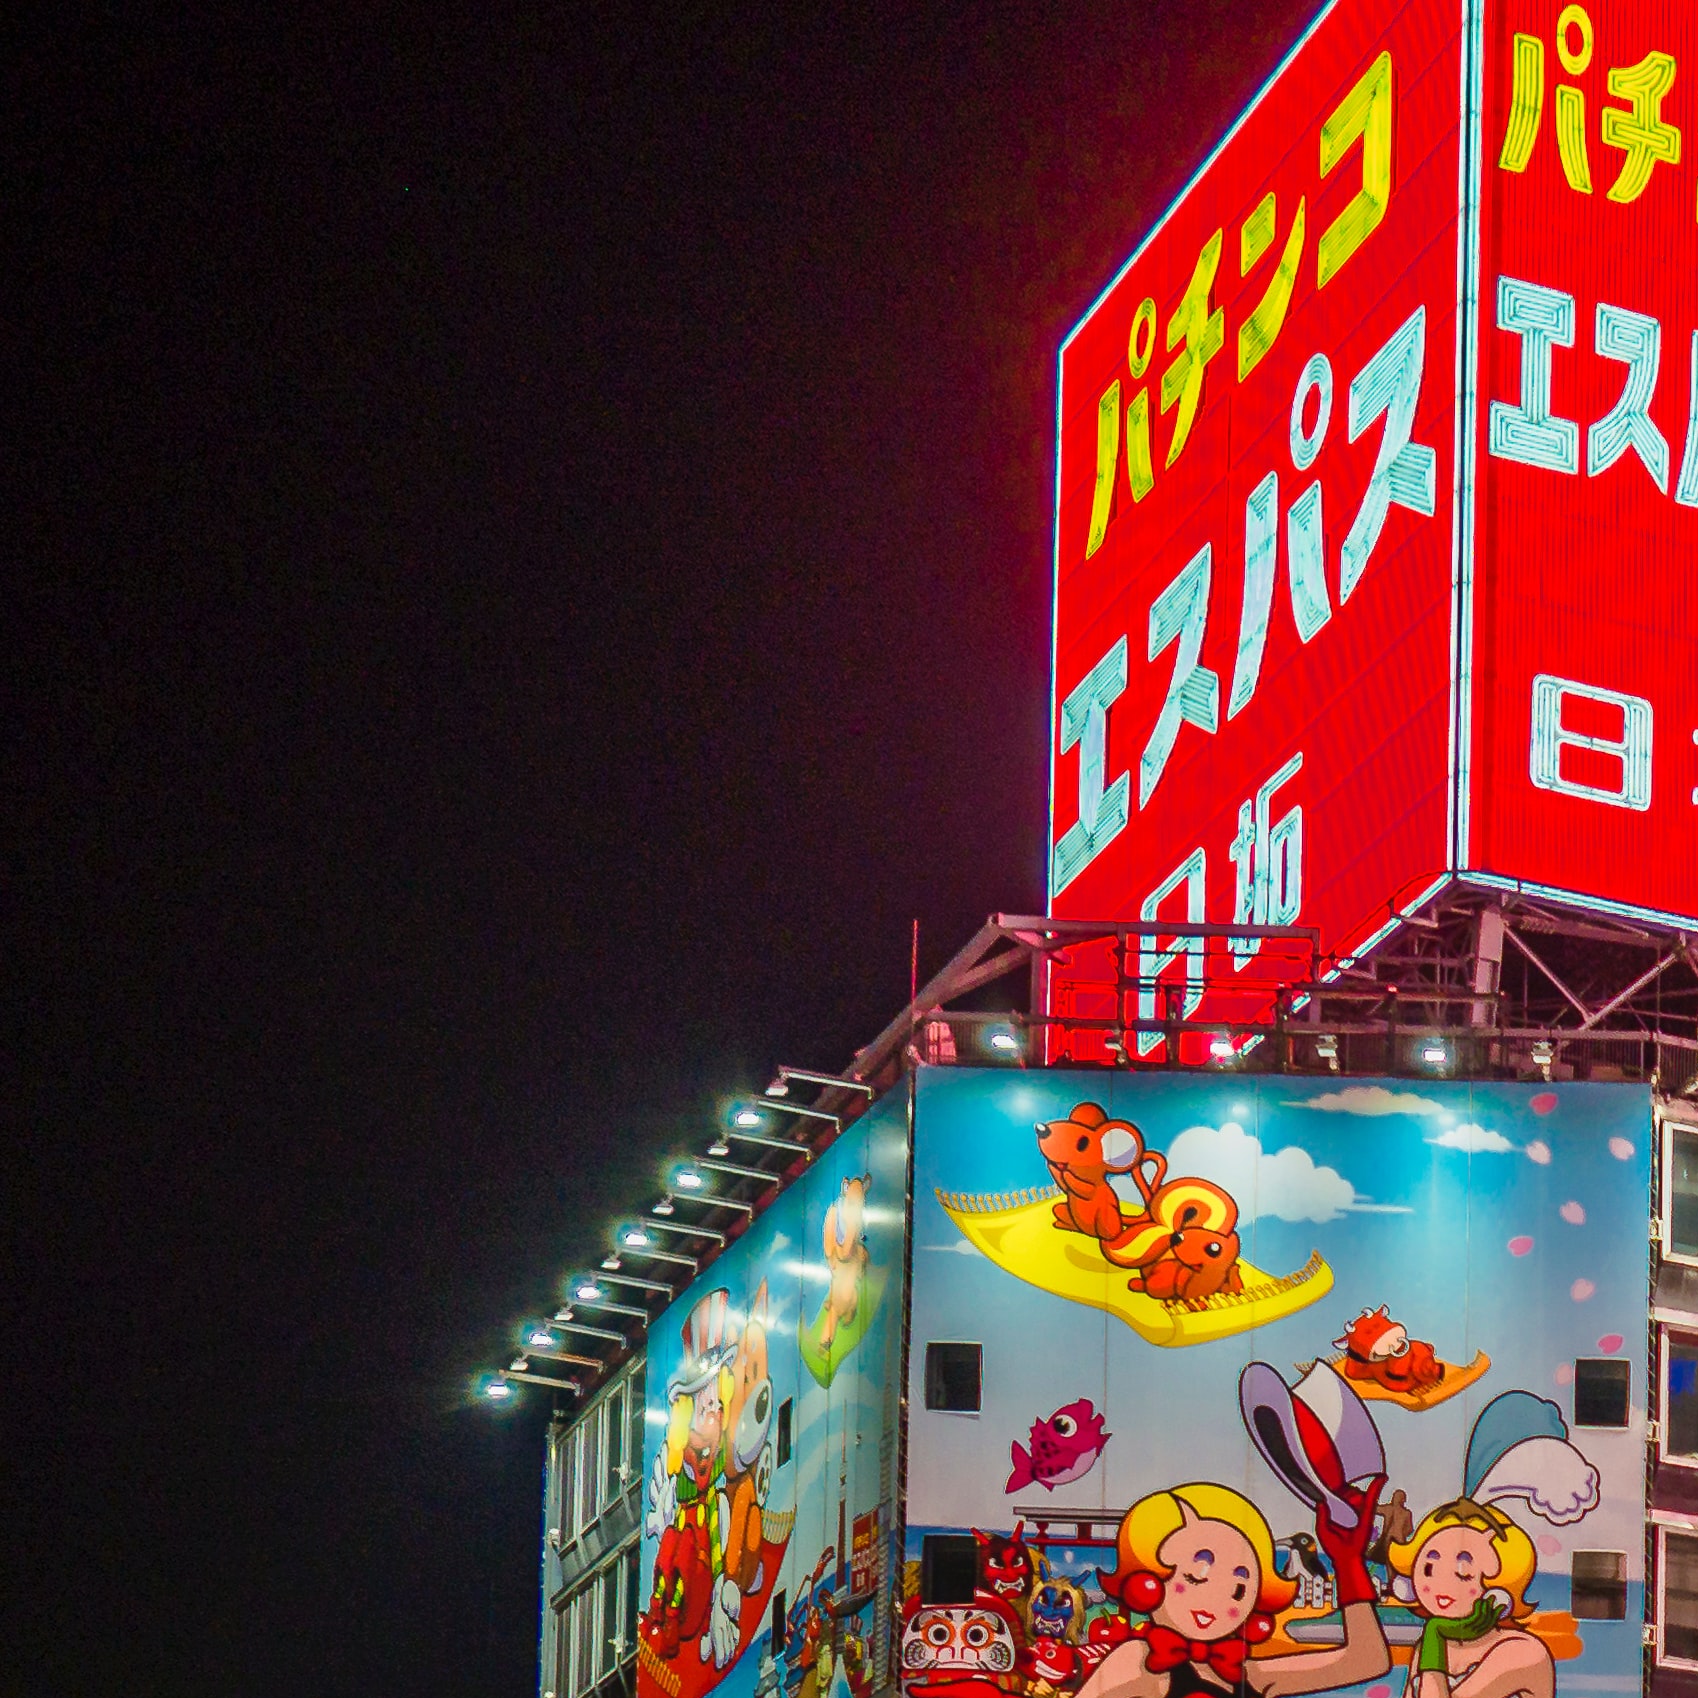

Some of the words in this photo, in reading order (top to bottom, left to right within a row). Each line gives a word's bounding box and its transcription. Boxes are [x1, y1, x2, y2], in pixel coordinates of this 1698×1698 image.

[1086, 48, 1393, 560] パチンコ
[1053, 303, 1437, 893] エスパス
